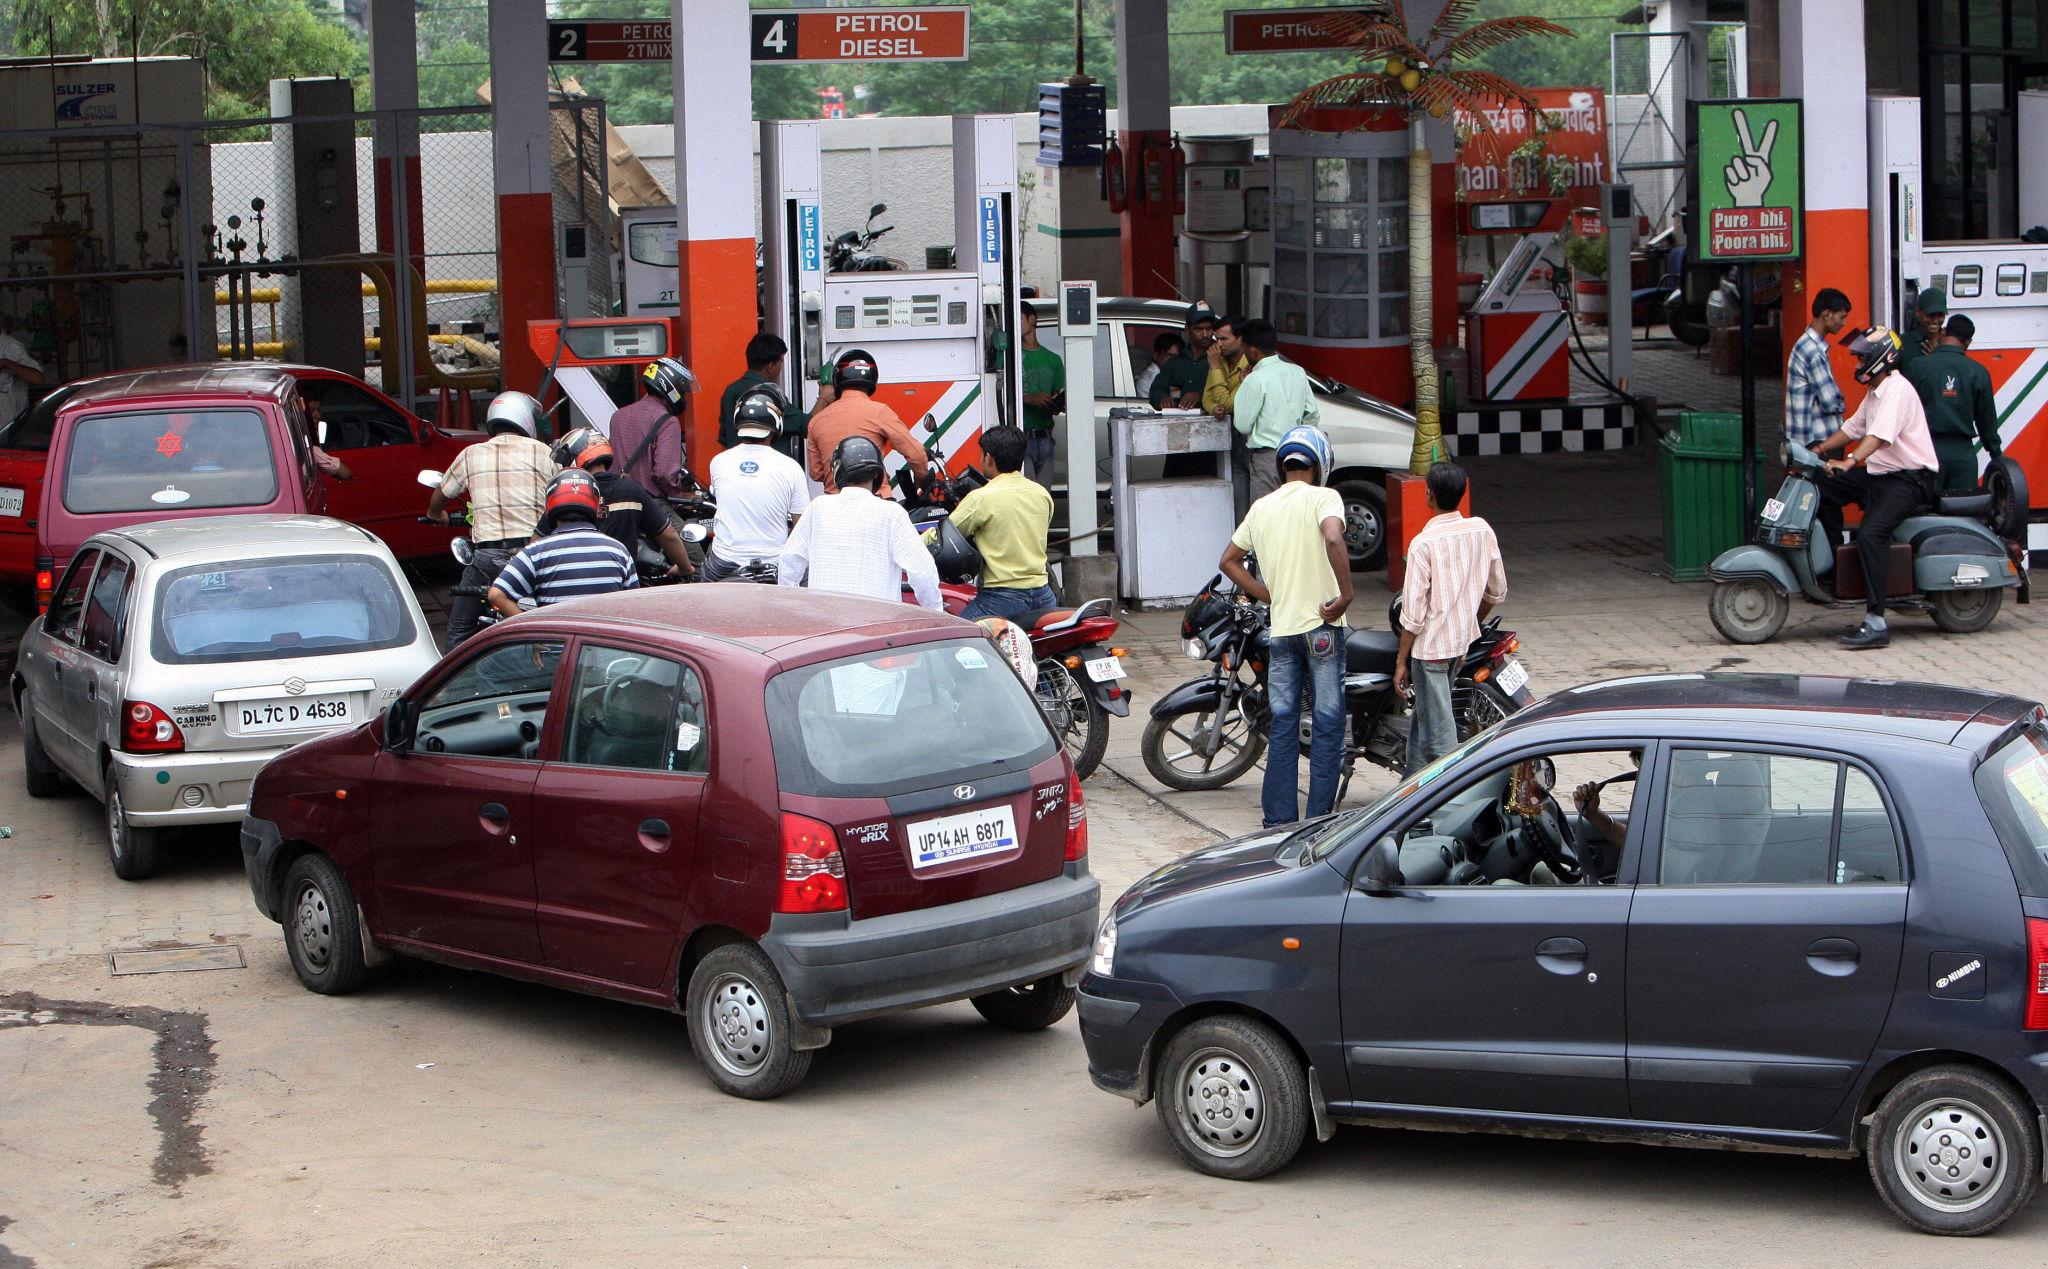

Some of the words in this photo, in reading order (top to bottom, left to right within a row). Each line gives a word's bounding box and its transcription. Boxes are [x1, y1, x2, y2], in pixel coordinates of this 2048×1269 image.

[622, 25, 672, 39] PETRO
[835, 15, 928, 33] PETROL
[559, 29, 578, 56] 2
[762, 19, 787, 53] 4
[840, 38, 922, 57] DIESEL
[56, 84, 116, 95] SULZER
[1715, 213, 1748, 228] Pure
[1760, 211, 1787, 227] bhi.
[805, 206, 815, 270] PETROL
[985, 199, 995, 262] DIESEL
[1715, 234, 1757, 250] Poora
[1760, 232, 1788, 249] bhi.
[1010, 628, 1019, 659] HONDA
[289, 706, 299, 721] D
[306, 702, 346, 719] 4638
[846, 822, 888, 836] HYUNDAI
[954, 827, 970, 846] AH
[976, 820, 1004, 841] 6817
[1947, 959, 1980, 982] NIMBUS
